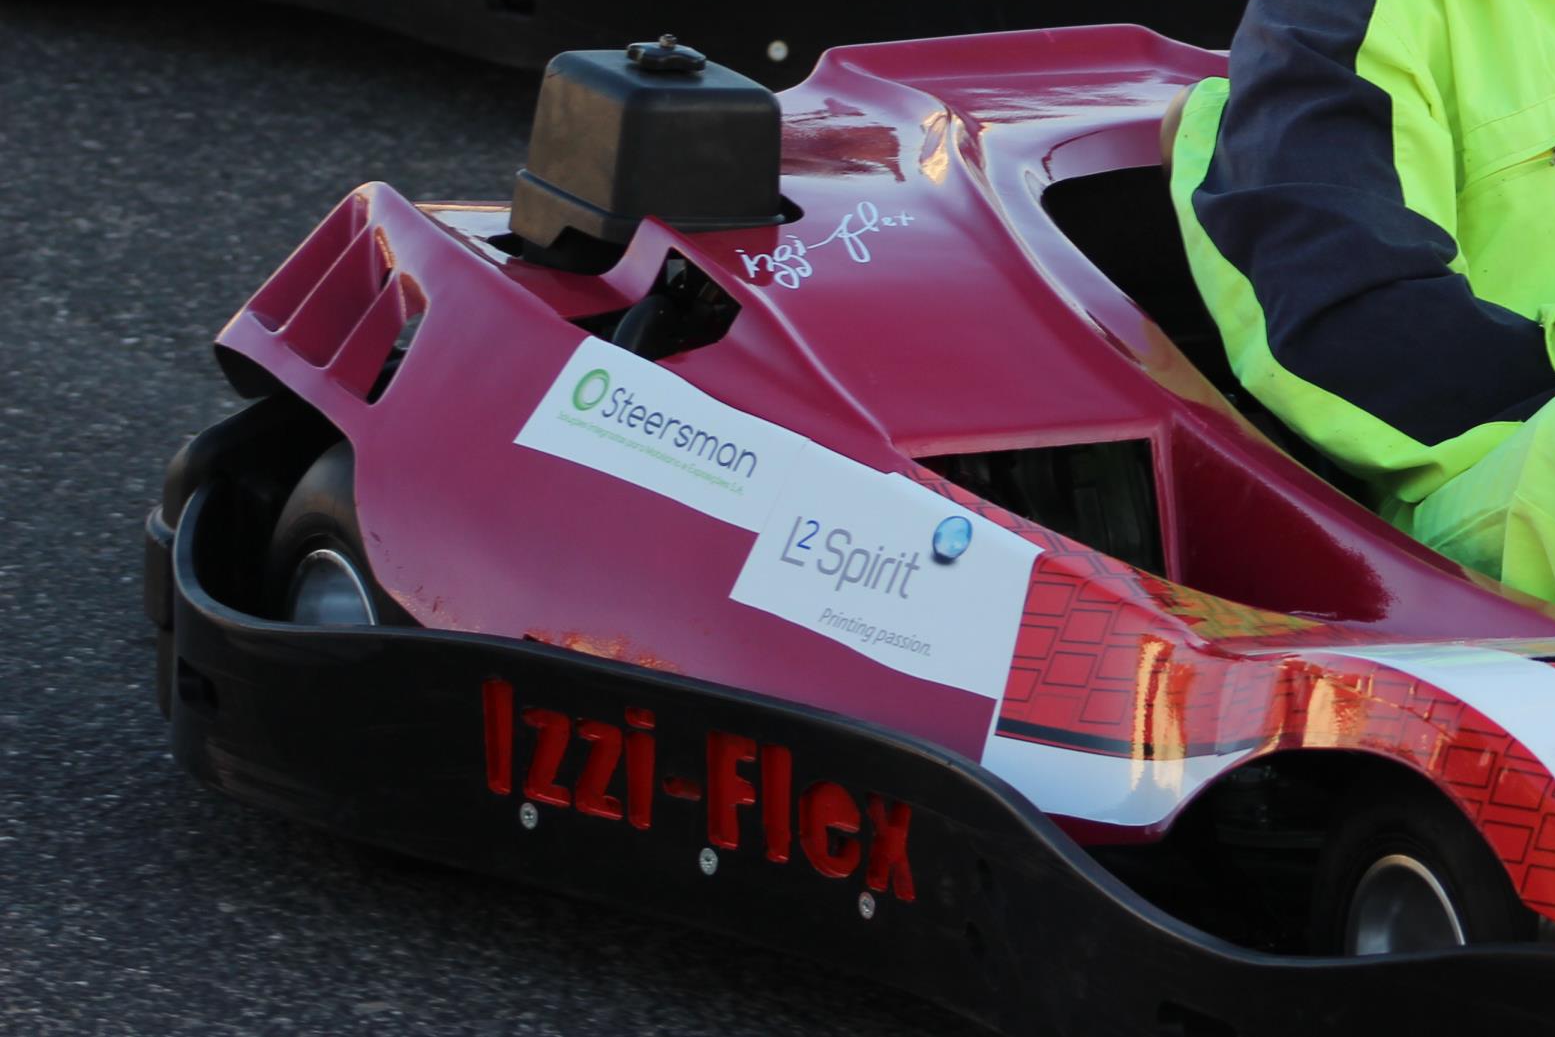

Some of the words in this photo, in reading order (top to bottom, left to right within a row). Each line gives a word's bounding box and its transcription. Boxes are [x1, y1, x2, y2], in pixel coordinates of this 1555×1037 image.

[601, 387, 758, 479] Steersman
[818, 607, 877, 643] Printing
[482, 678, 916, 903] Izzi-Flex
